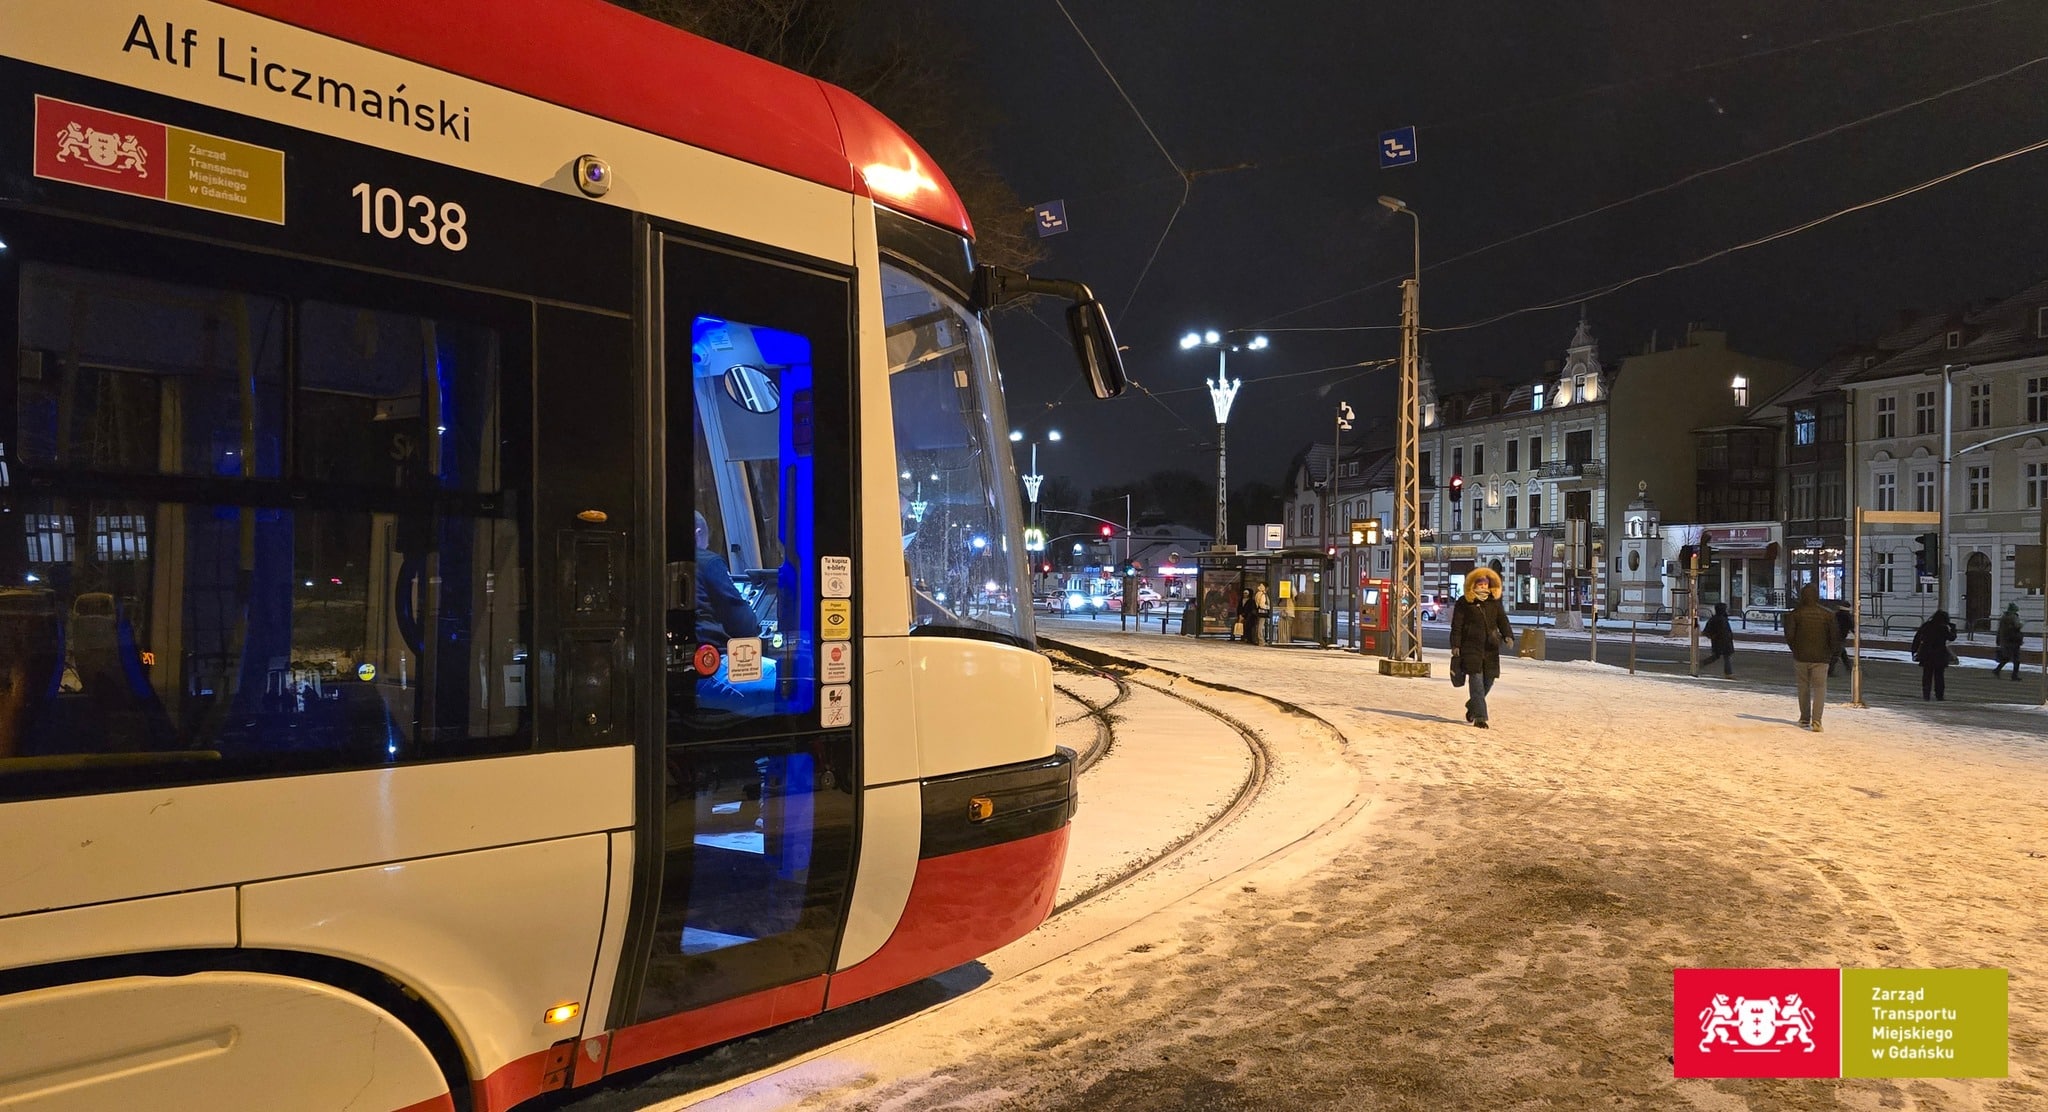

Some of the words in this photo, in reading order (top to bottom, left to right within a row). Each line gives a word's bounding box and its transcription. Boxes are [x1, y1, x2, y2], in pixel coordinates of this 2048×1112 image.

[122, 14, 197, 69] Alf
[218, 37, 471, 143] Liczmański
[188, 143, 227, 162] Zarząd
[188, 157, 249, 179] Transportu
[188, 170, 247, 192] Miejskiego
[188, 184, 199, 194] w
[200, 185, 247, 204] Gdańsku
[351, 182, 468, 251] 1038
